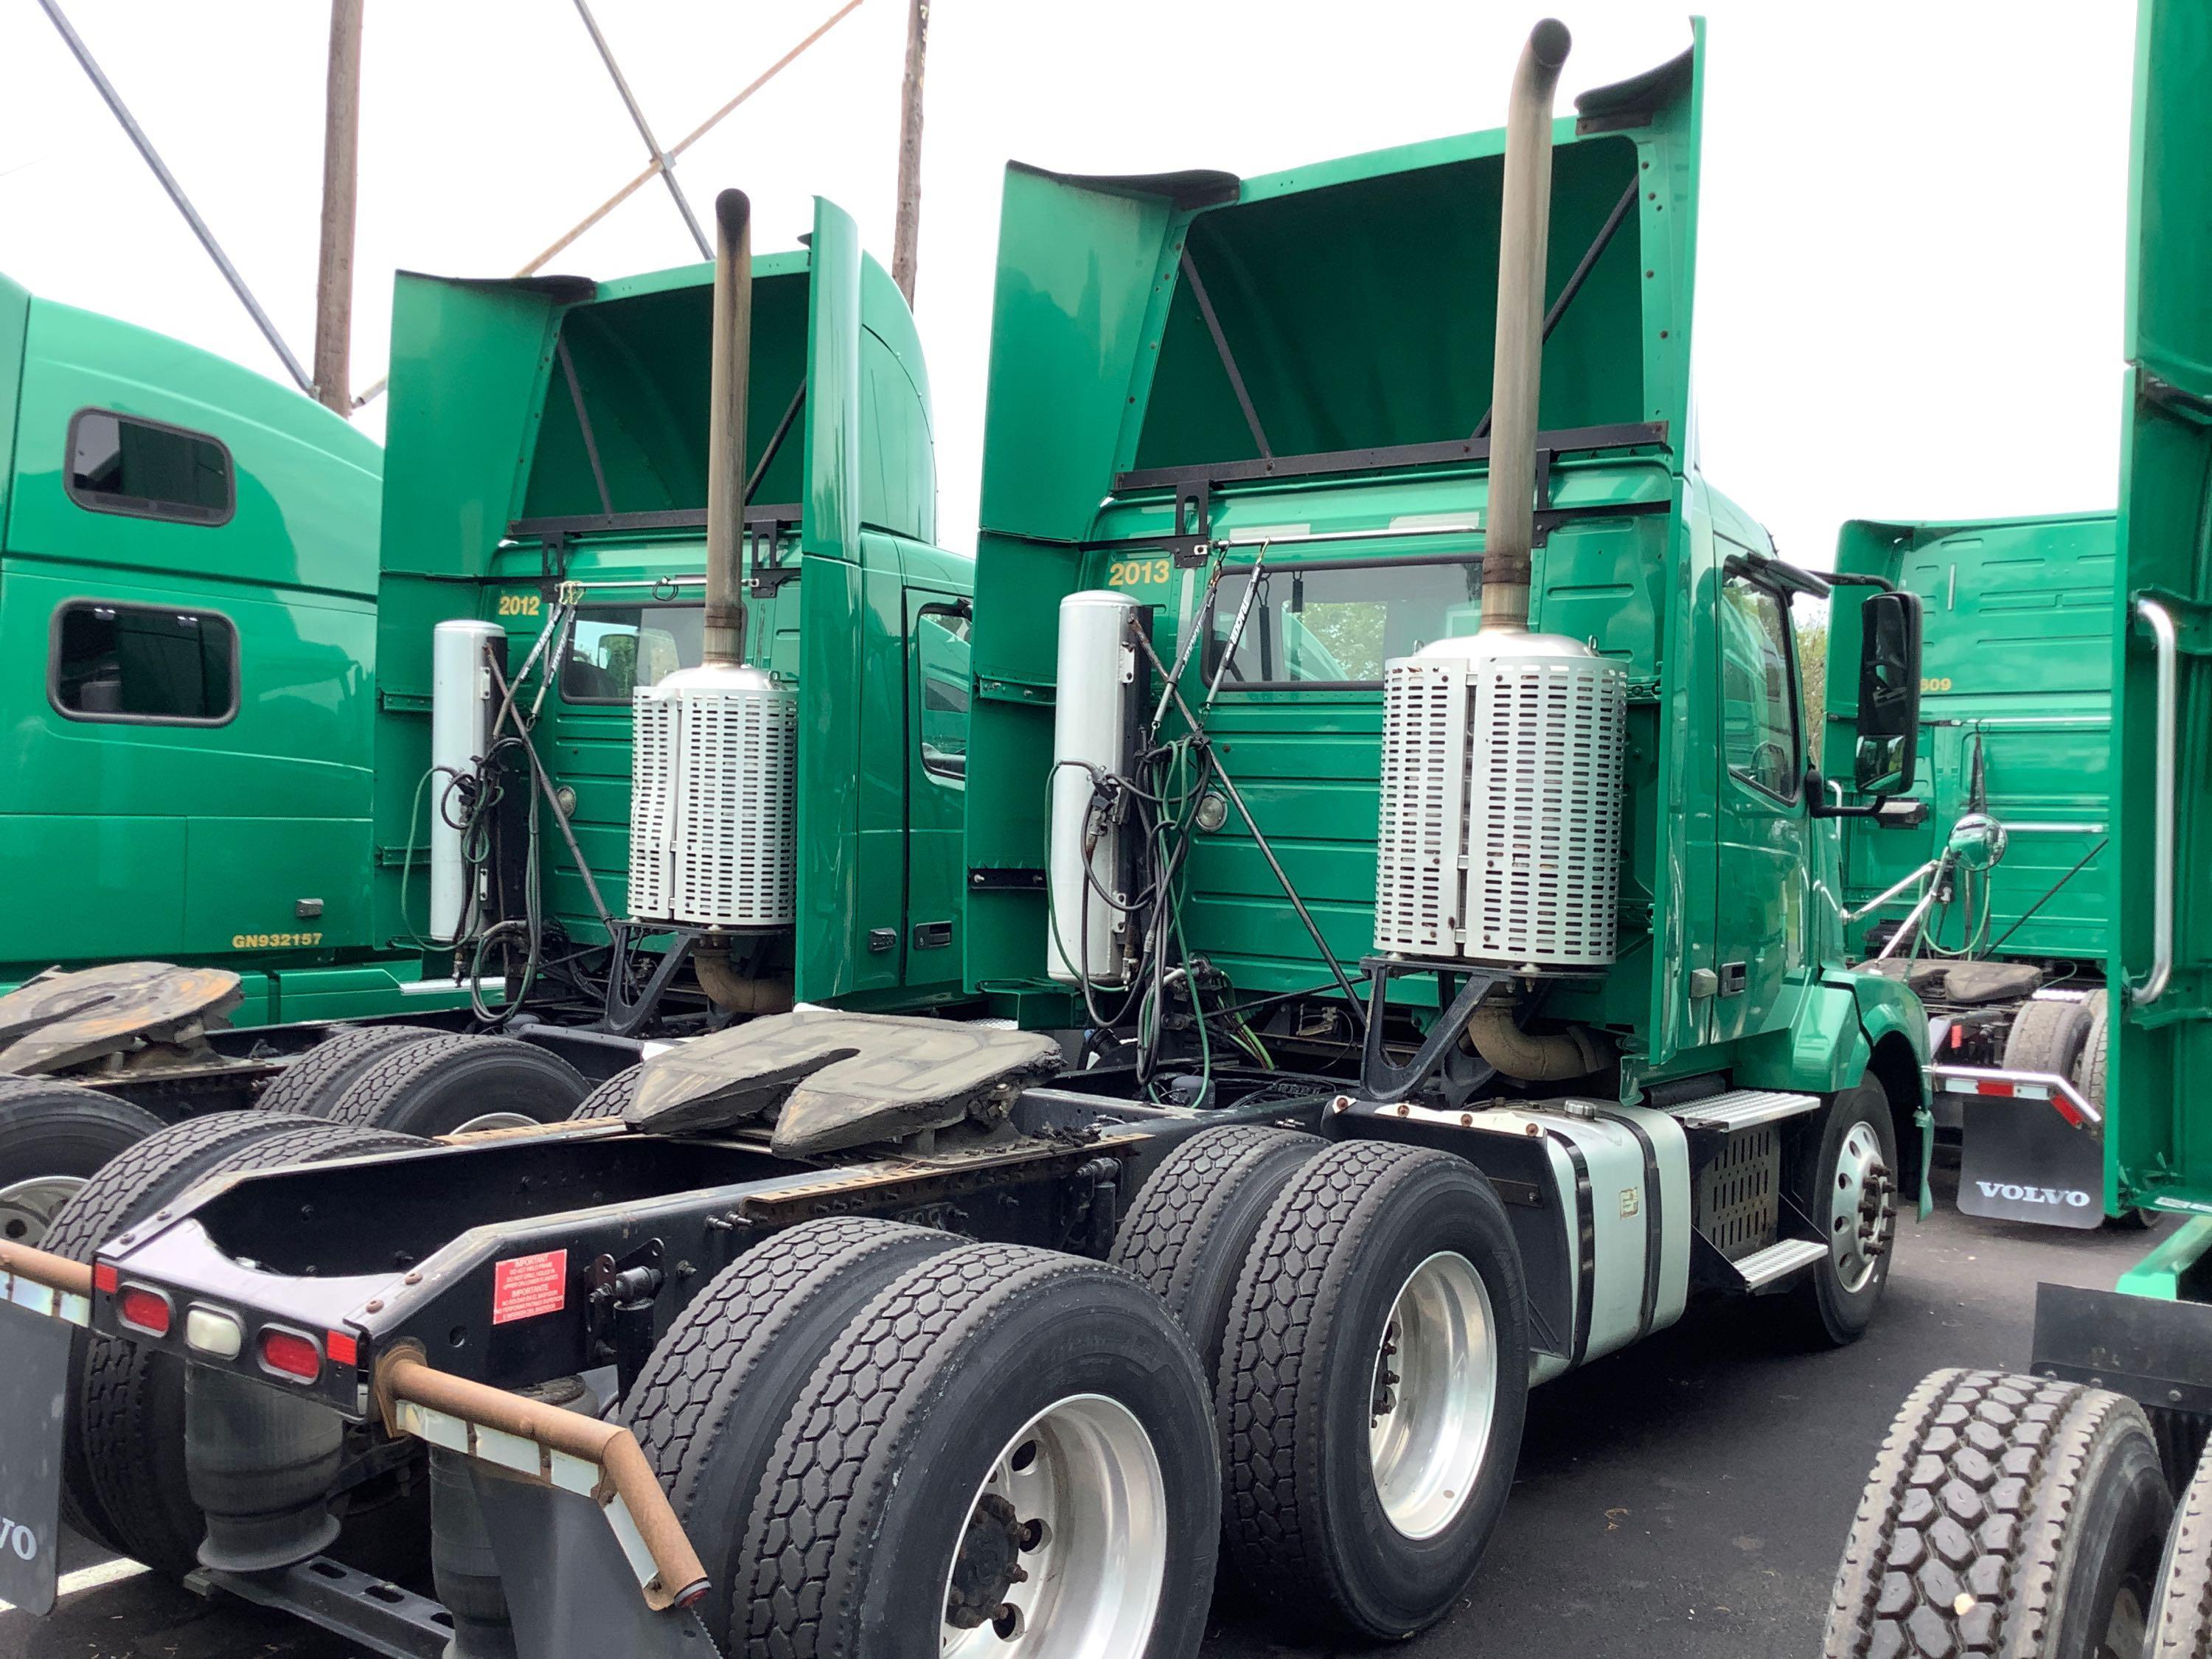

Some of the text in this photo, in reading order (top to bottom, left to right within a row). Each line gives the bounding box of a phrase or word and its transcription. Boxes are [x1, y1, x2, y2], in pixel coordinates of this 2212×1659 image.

[1109, 560, 1169, 585] 2013
[498, 596, 540, 616] 2012
[1228, 599, 1251, 645] TRACKER
[232, 933, 323, 948] GN932157
[1976, 1181, 2090, 1207] VOLVO
[515, 1255, 549, 1268] IMPORTANT
[512, 1284, 549, 1298] IMPORTANTE
